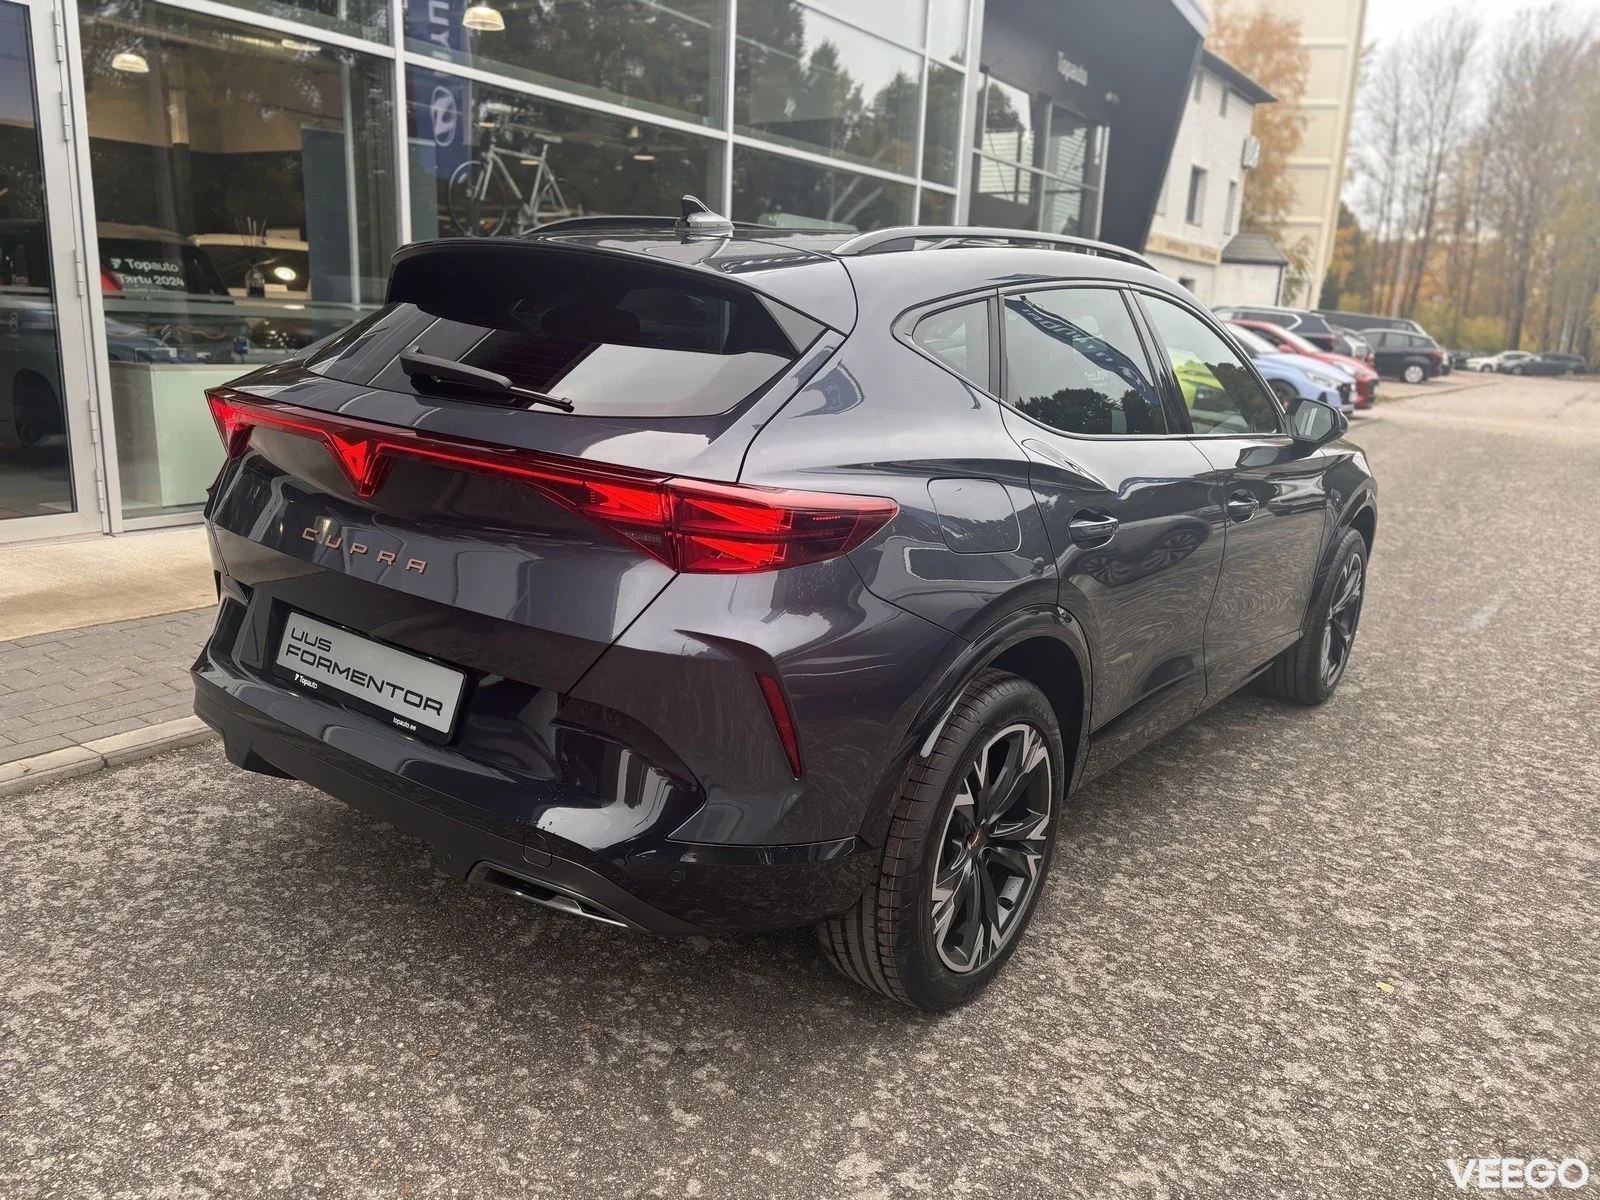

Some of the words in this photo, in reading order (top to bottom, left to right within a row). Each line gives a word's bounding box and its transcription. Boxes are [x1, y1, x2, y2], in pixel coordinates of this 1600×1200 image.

[124, 258, 179, 272] Topauto
[153, 275, 185, 287] 2024
[301, 527, 428, 574] CUPRA
[290, 627, 333, 653] UUS
[285, 643, 444, 716] FORMENTOR
[299, 675, 318, 690] Topauto
[392, 716, 417, 731] topauto.ee
